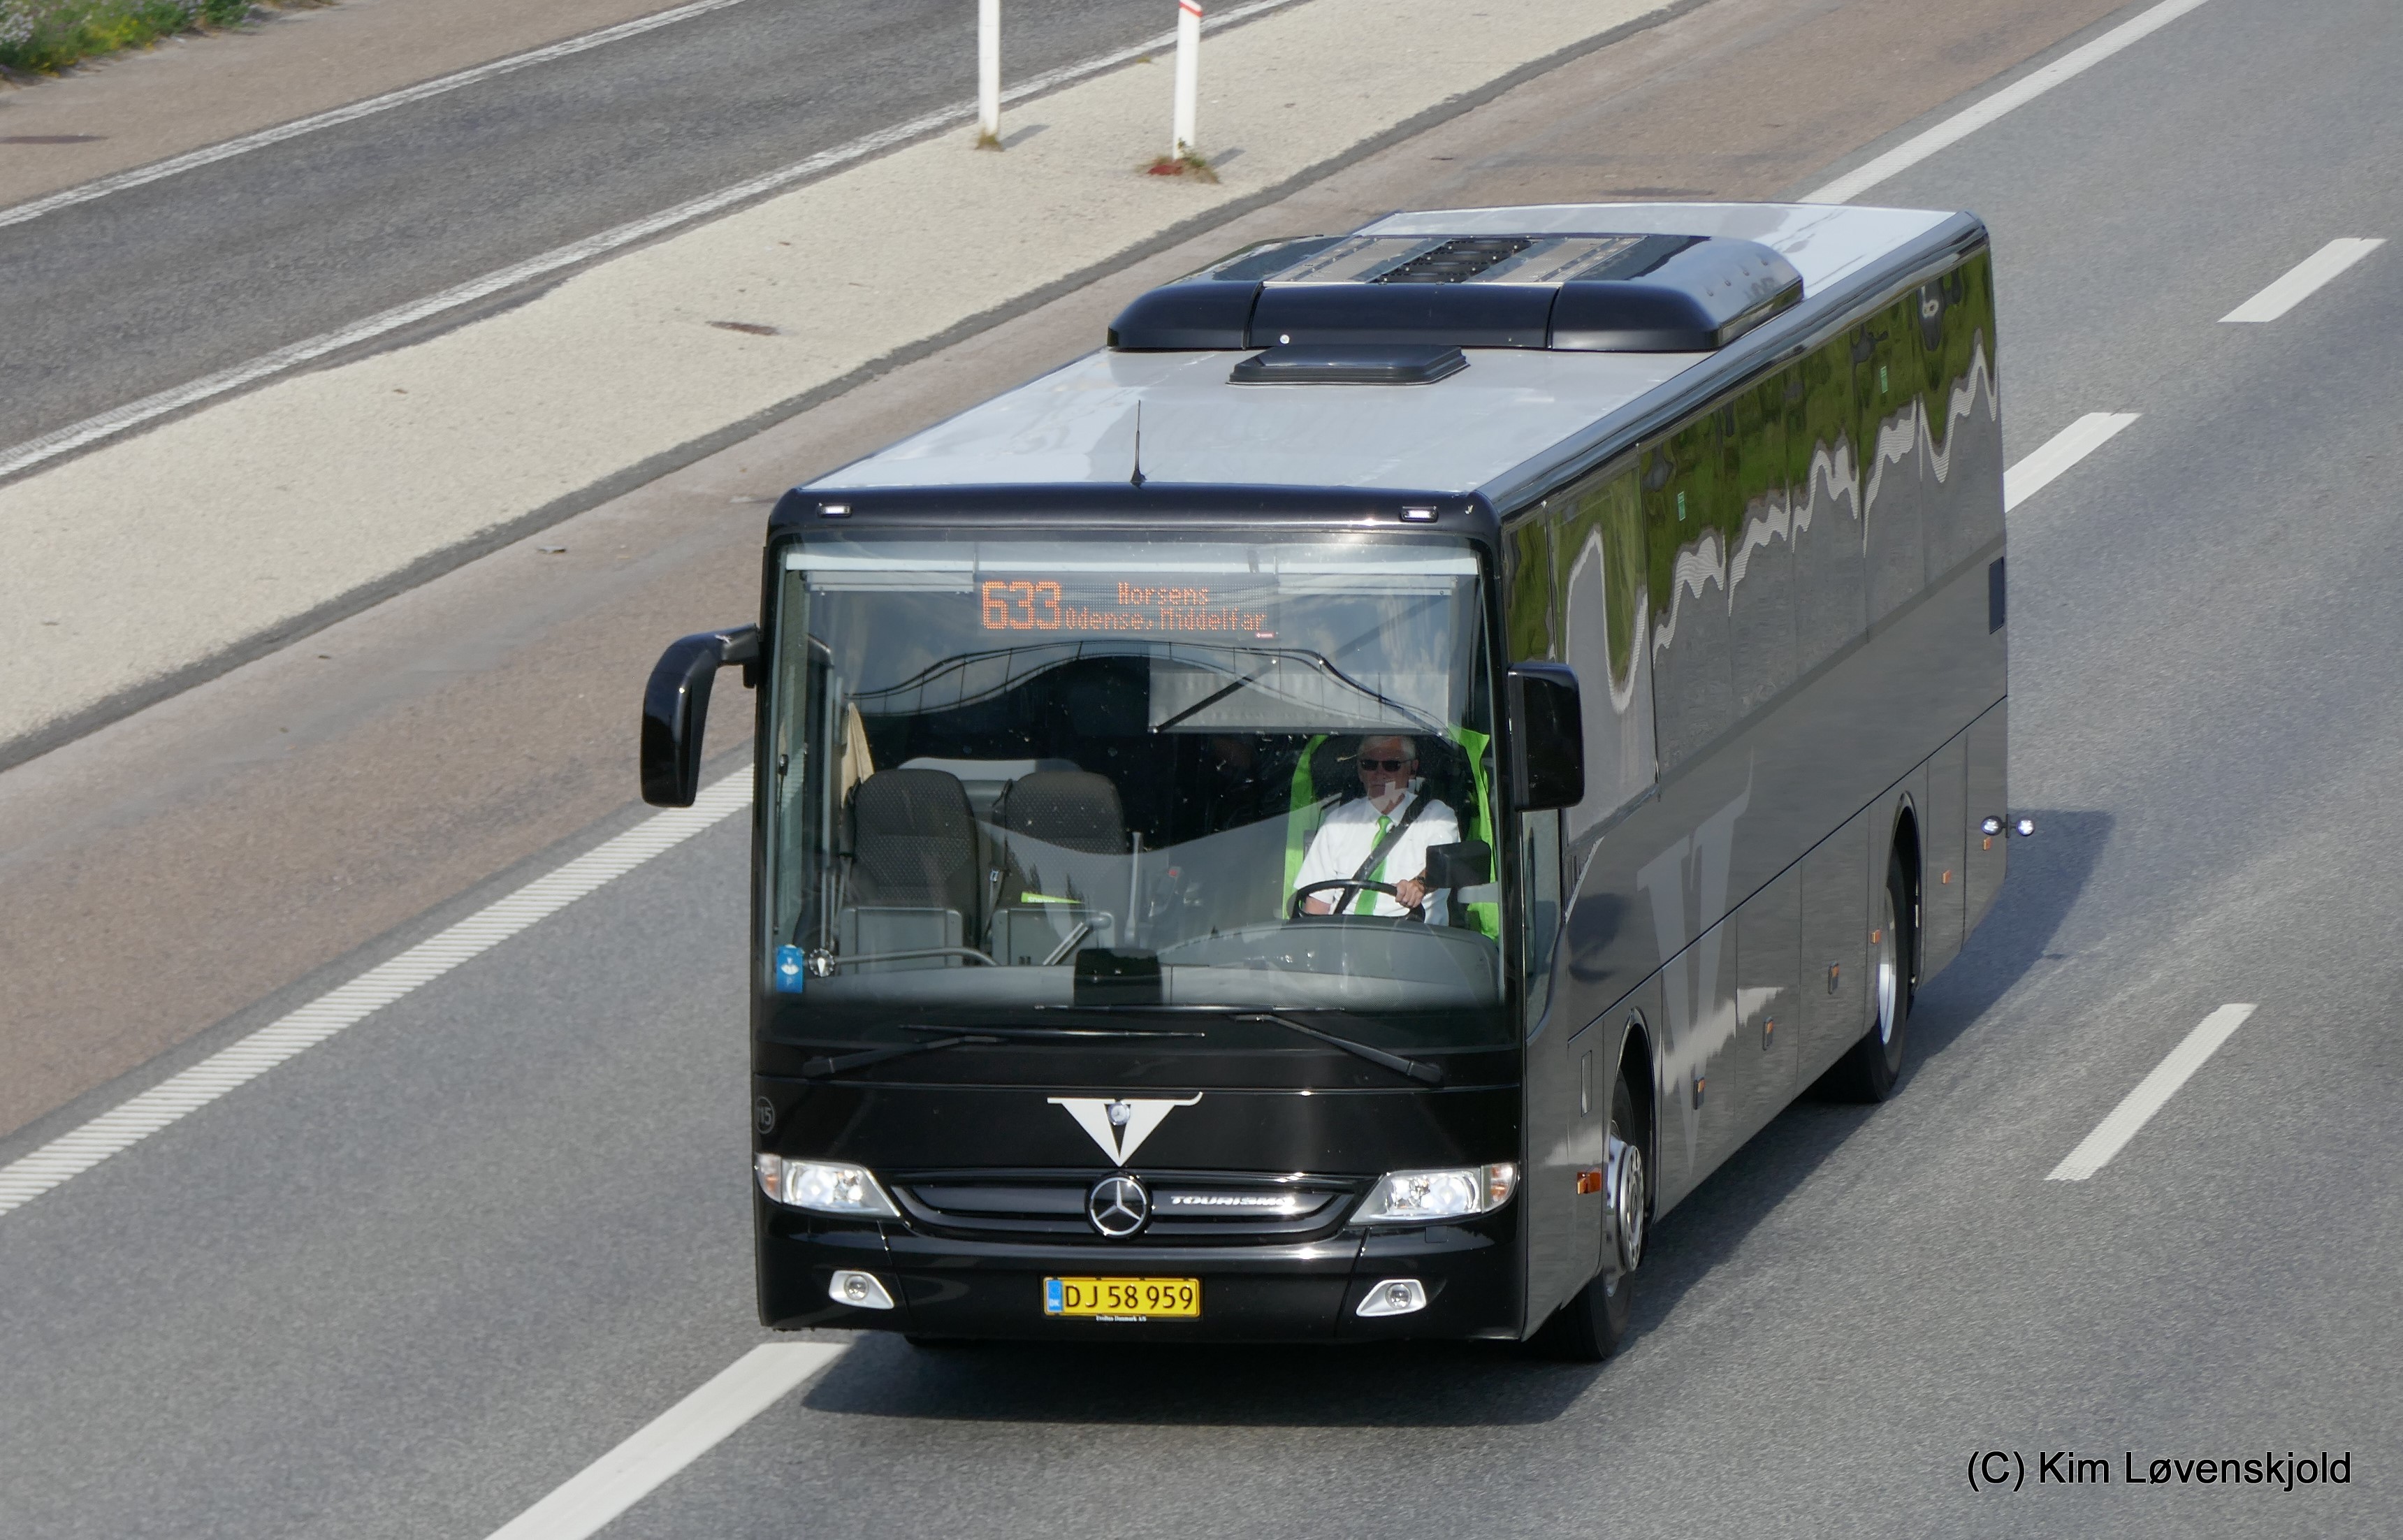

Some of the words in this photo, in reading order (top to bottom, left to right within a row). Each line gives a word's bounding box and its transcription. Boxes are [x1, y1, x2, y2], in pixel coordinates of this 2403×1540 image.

[982, 581, 1061, 630] 633
[1118, 581, 1210, 606] Horsens
[1170, 1196, 1295, 1207] TOURISMO
[1066, 1285, 1098, 1308] DJ
[1108, 1284, 1138, 1309] 58
[1146, 1285, 1193, 1310] 959
